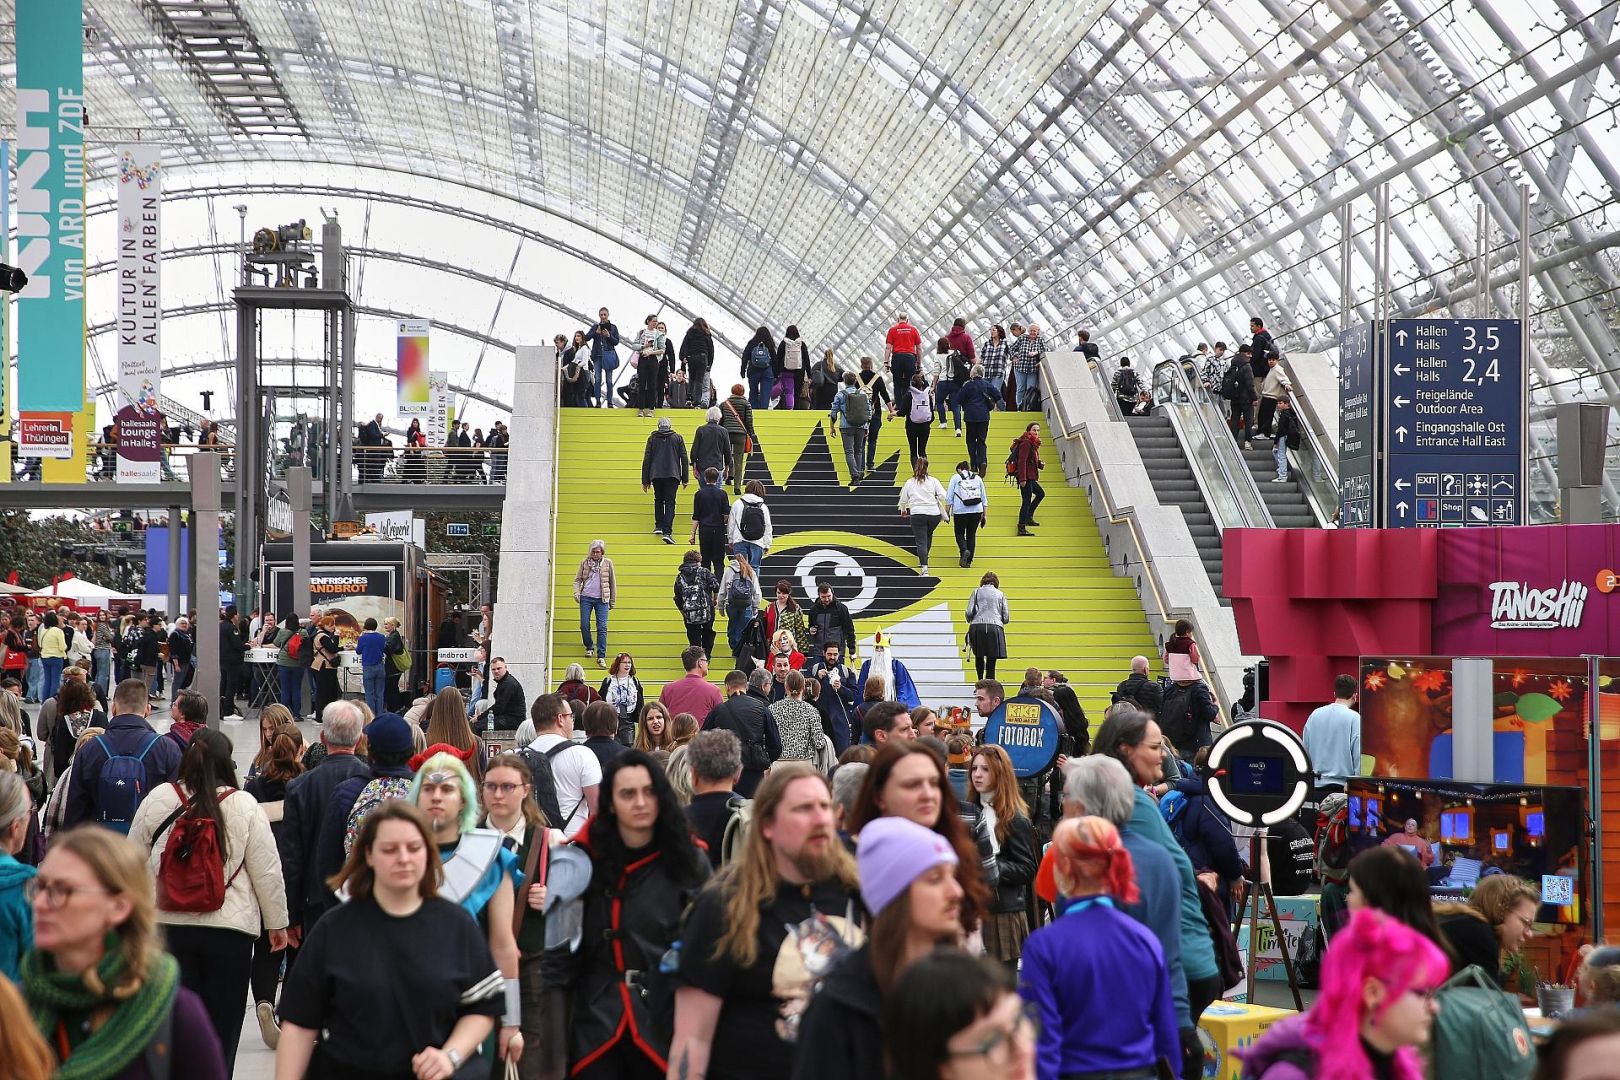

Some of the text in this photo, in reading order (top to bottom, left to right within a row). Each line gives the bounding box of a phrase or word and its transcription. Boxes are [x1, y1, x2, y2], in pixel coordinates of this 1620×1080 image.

[58, 87, 84, 301] von ARD und ZDF
[142, 197, 157, 345] ALLEN FARBEN
[121, 239, 137, 346] KULTUR IN
[1416, 325, 1448, 337] Hallen
[1416, 339, 1441, 351] Halls
[1462, 326, 1500, 354] 3,5
[1416, 357, 1448, 369] Hallen
[1416, 371, 1441, 383] Halls
[1462, 358, 1501, 386] 2,4
[1416, 389, 1474, 404] Freigelände
[437, 395, 446, 434] FARBEN
[1416, 403, 1483, 416] Outdoor Area
[24, 423, 58, 433] Lehrerin
[121, 419, 157, 428] hallesaale
[1416, 421, 1505, 436] Eingangshalle Ost
[25, 433, 67, 444] Thüringen
[121, 428, 157, 439] Lounge
[121, 439, 129, 447] in
[130, 439, 151, 447] Halle
[1416, 435, 1506, 447] Entrance Hall East
[1417, 476, 1437, 484] EXIT
[1442, 503, 1463, 512] Shop
[310, 576, 368, 585] ENFRISCHES
[310, 584, 368, 593] ANDBROT
[998, 725, 1044, 748] FOTOBOX
